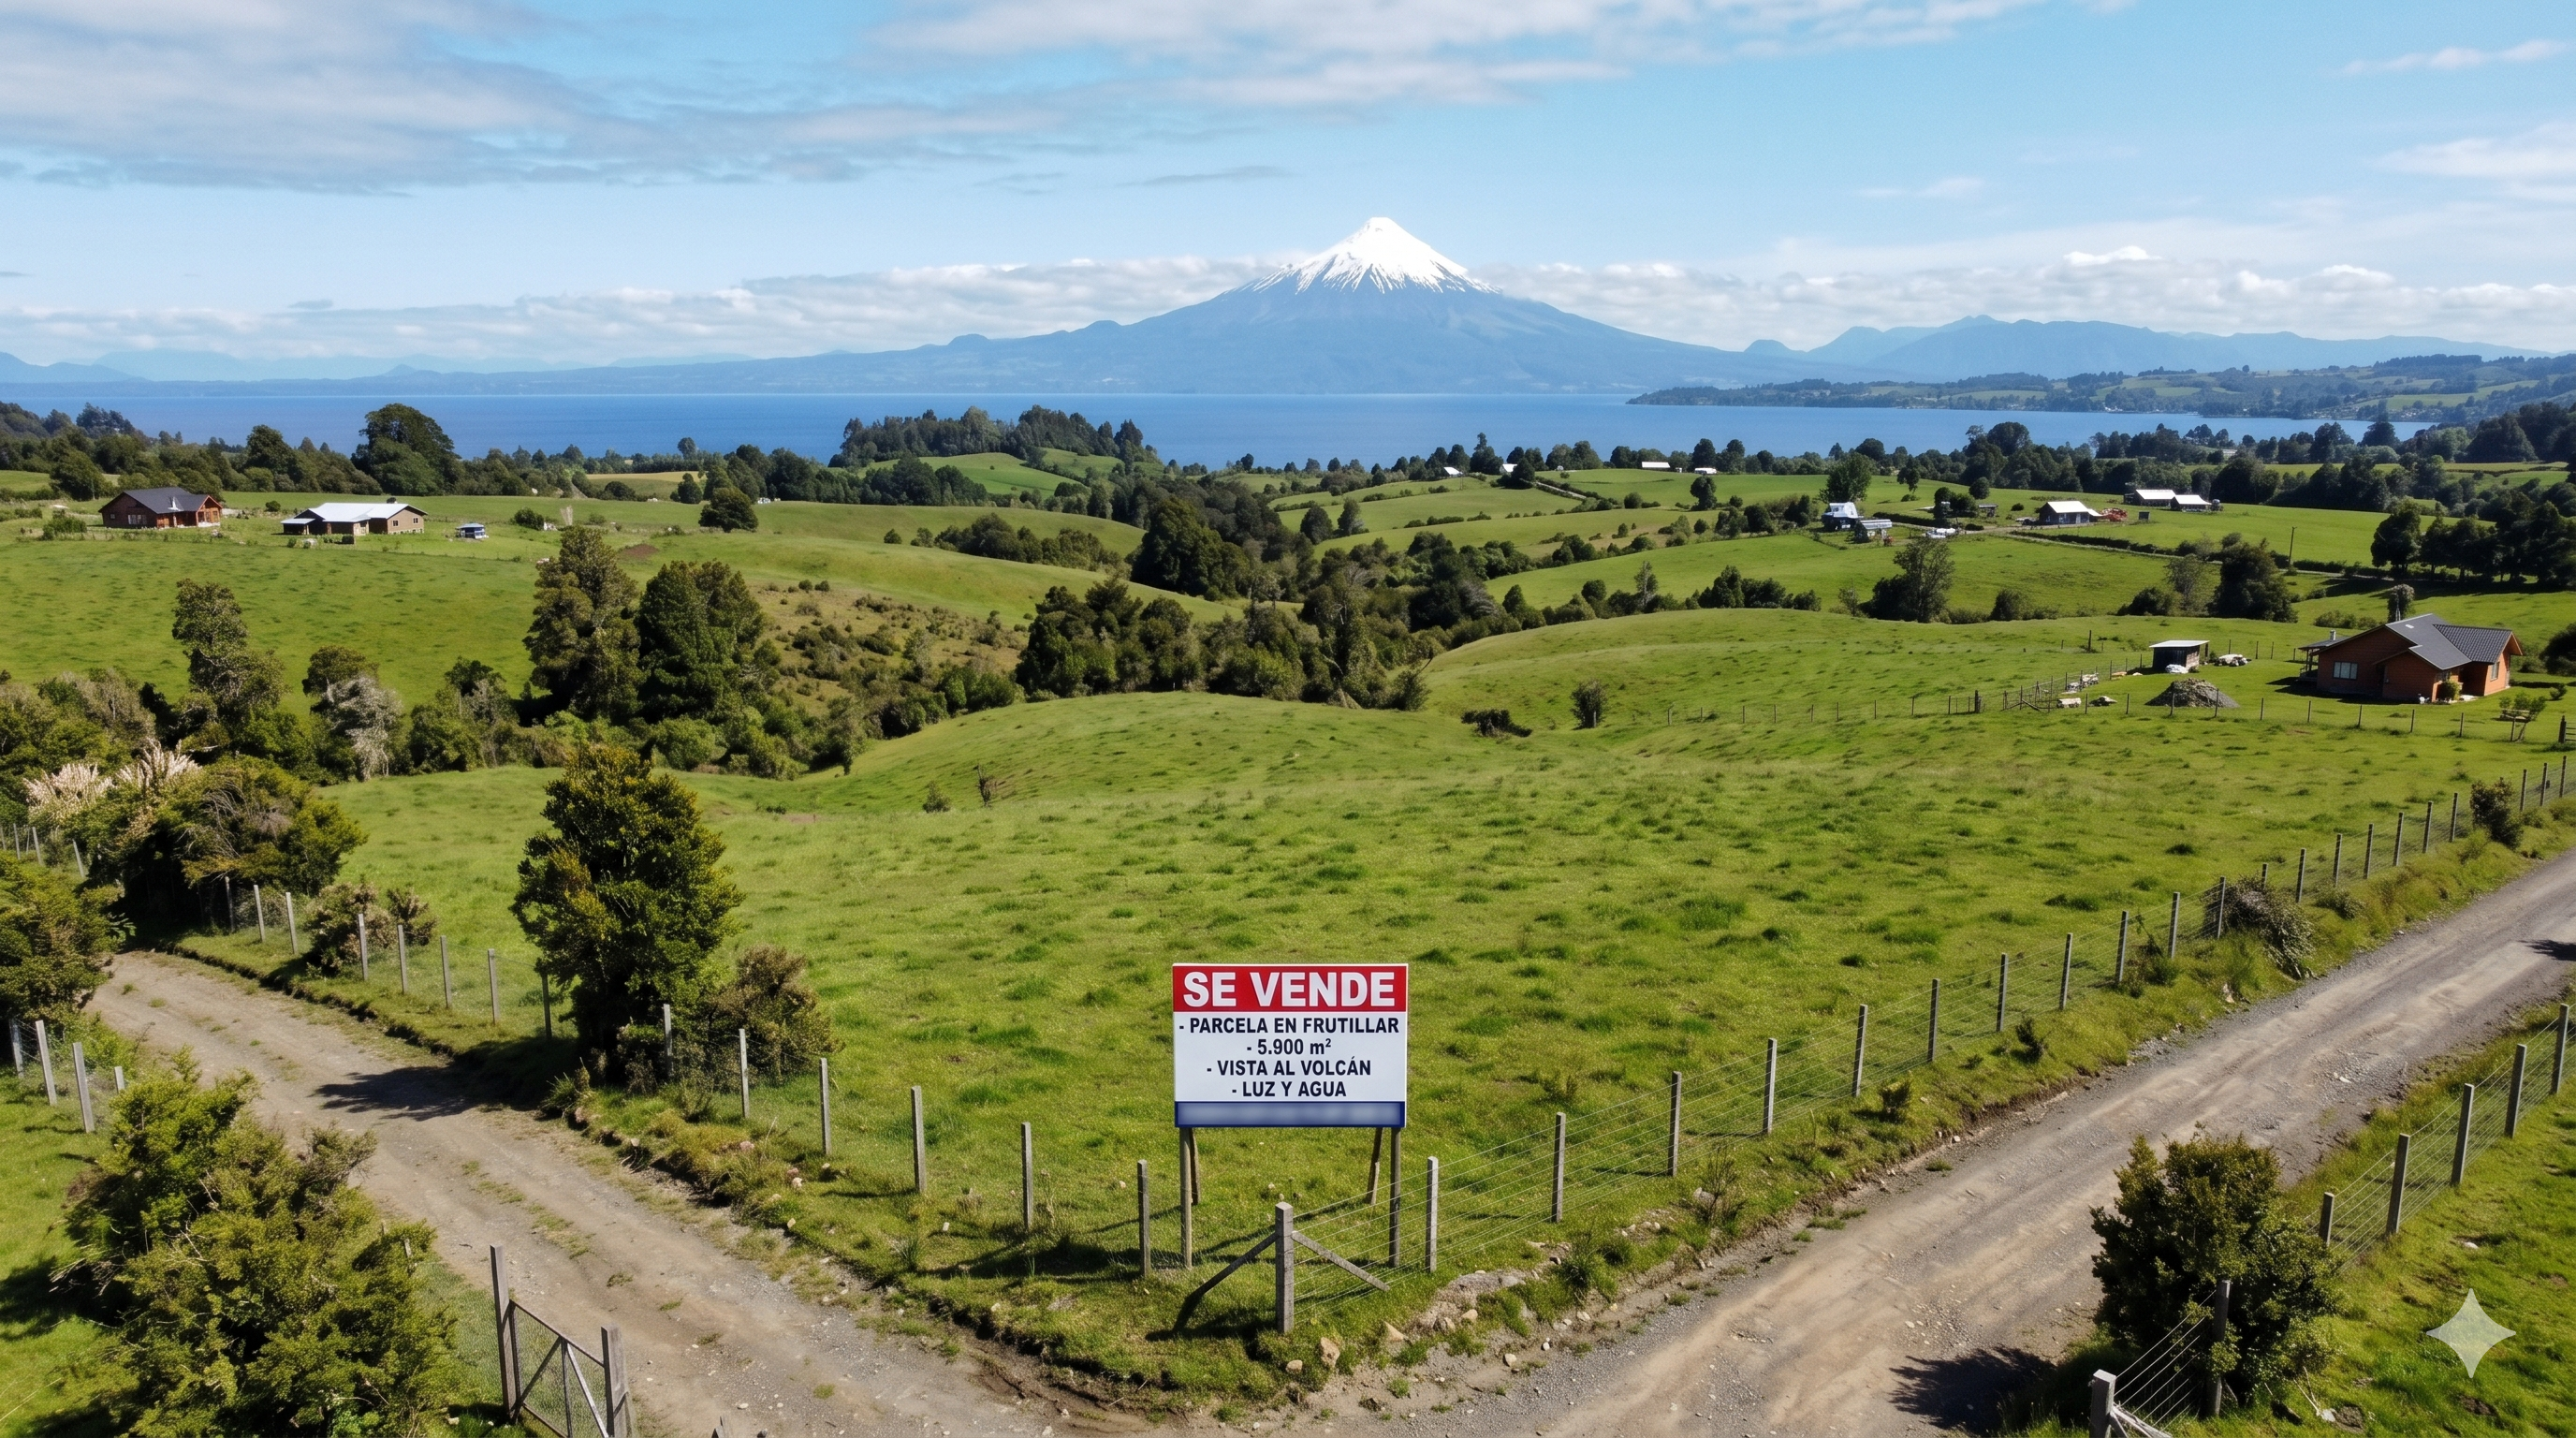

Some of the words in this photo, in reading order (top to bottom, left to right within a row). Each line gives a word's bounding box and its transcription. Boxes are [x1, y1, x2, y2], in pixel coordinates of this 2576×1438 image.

[1183, 972, 1237, 1007] SE
[1250, 972, 1395, 1007] VENDE
[1190, 1018, 1268, 1034] PARCELA
[1274, 1018, 1296, 1034] EN
[1303, 1018, 1399, 1034] FRUTILLAR
[1258, 1039, 1303, 1055] 5.900
[1310, 1038, 1331, 1055] m²
[1217, 1061, 1267, 1076] VISTA
[1273, 1061, 1295, 1076] AL
[1301, 1056, 1370, 1076] VOLCÁN
[1243, 1081, 1275, 1097] LUZ
[1281, 1081, 1292, 1097] Y
[1298, 1081, 1346, 1097] AGUA
